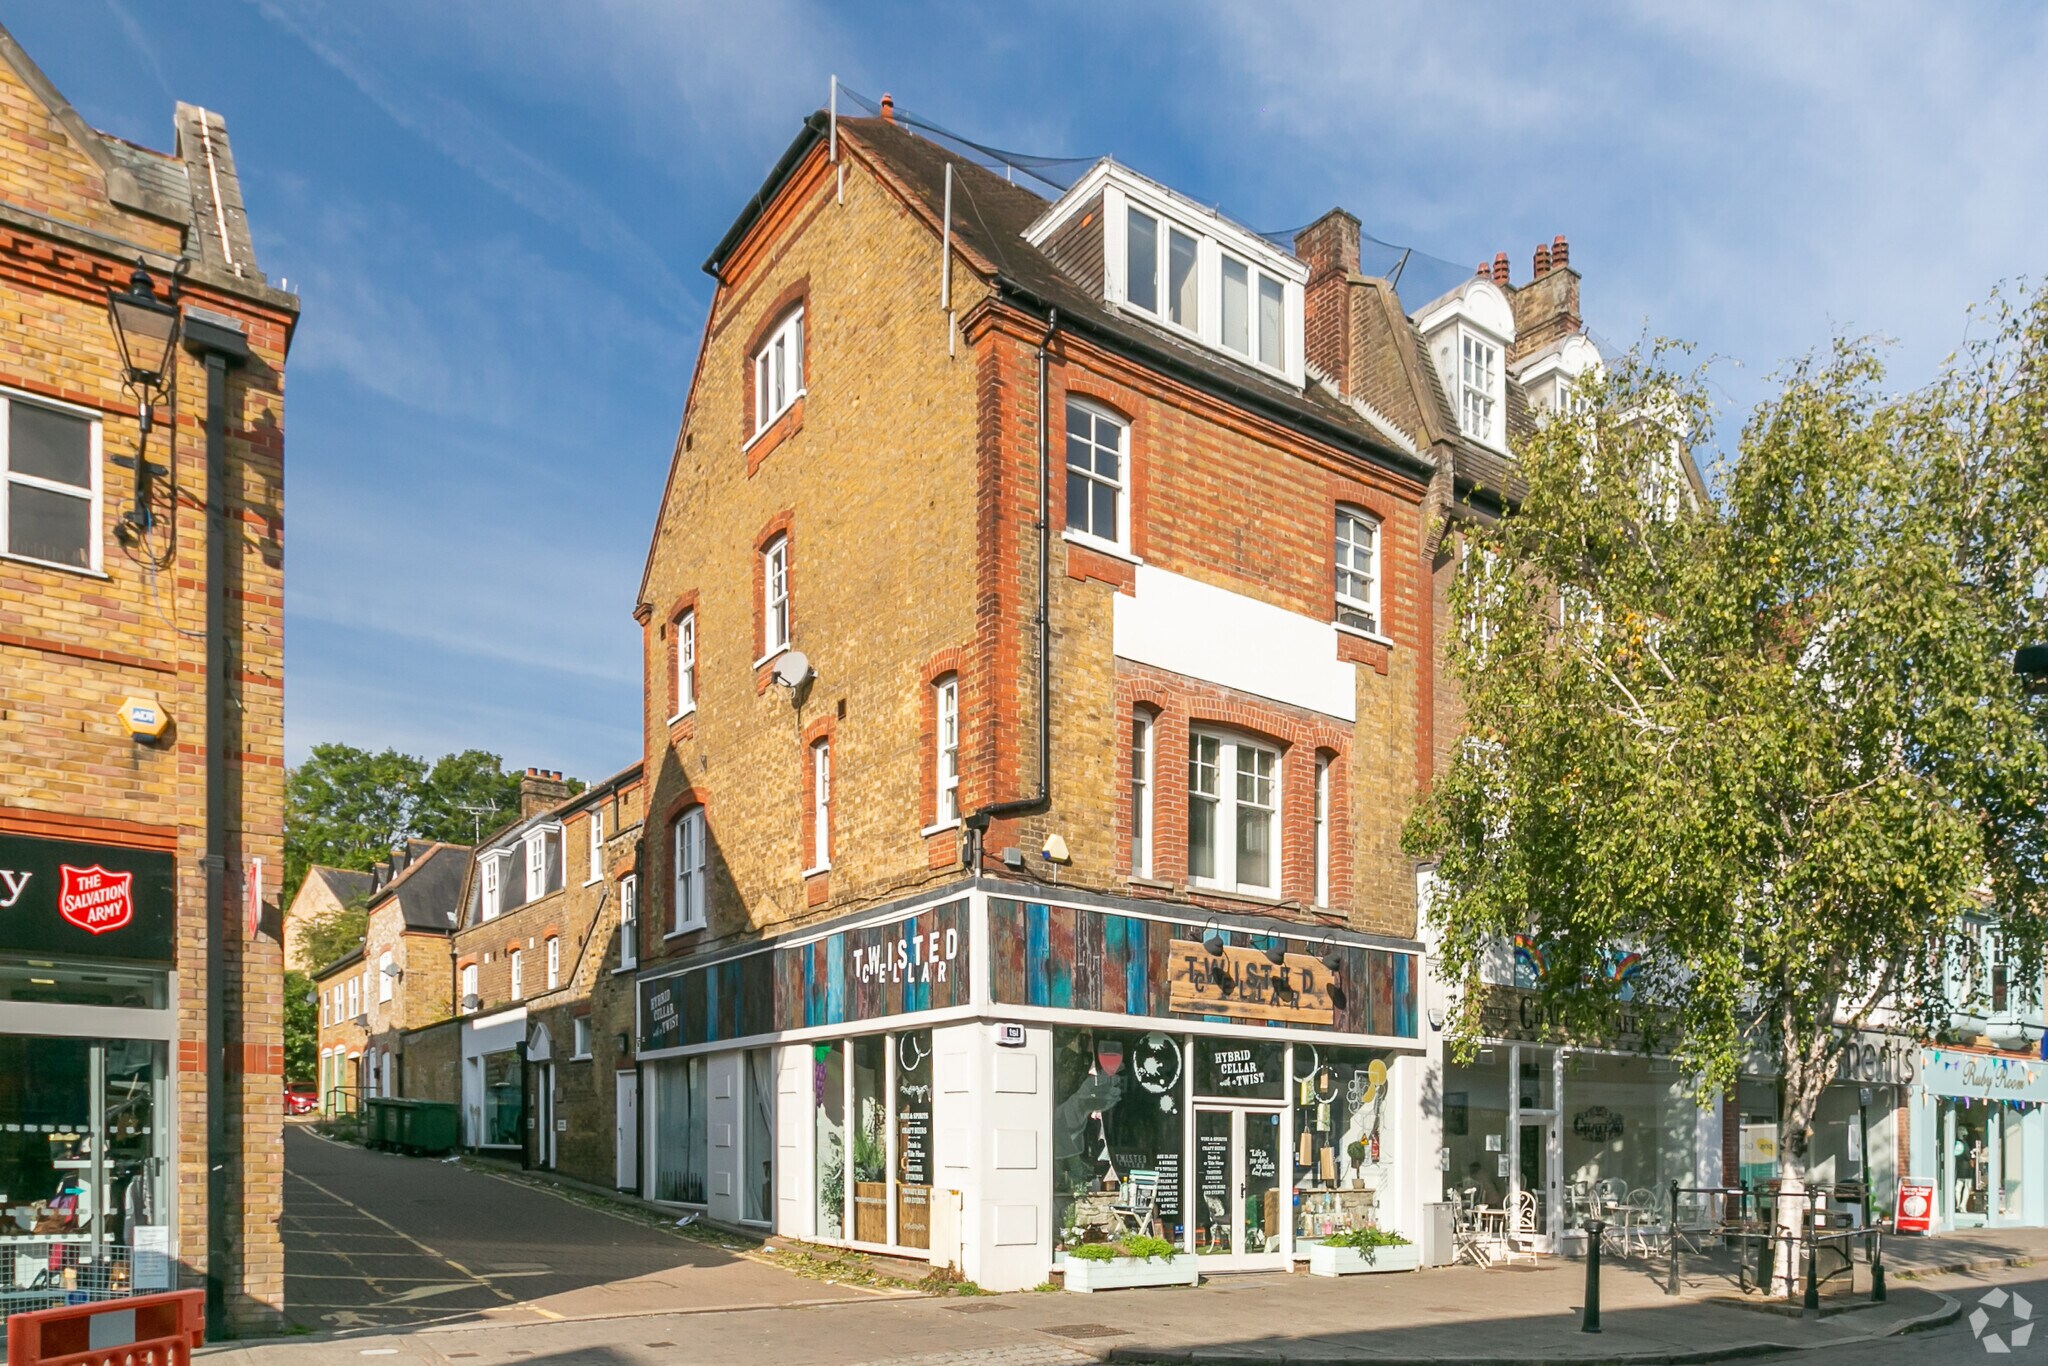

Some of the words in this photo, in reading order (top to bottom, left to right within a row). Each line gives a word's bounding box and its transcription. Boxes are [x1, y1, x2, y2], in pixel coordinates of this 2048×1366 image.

[77, 874, 101, 891] THE
[65, 881, 126, 912] SALVATION
[87, 899, 123, 924] ARMY
[853, 928, 958, 978] TWISTED
[862, 961, 947, 984] CELLAR
[1185, 956, 1313, 994] TWISTED
[650, 989, 671, 1011] HYBRID
[653, 1003, 674, 1022] CELLAR
[662, 1013, 679, 1034] TWIST
[1214, 1049, 1251, 1064] HYBRID
[1220, 1062, 1257, 1074] CELLAR
[1963, 1061, 1992, 1096] Ruby
[1995, 1065, 2025, 1090] Room
[1236, 1072, 1265, 1086] TWIST
[1261, 1162, 1275, 1170] drink
